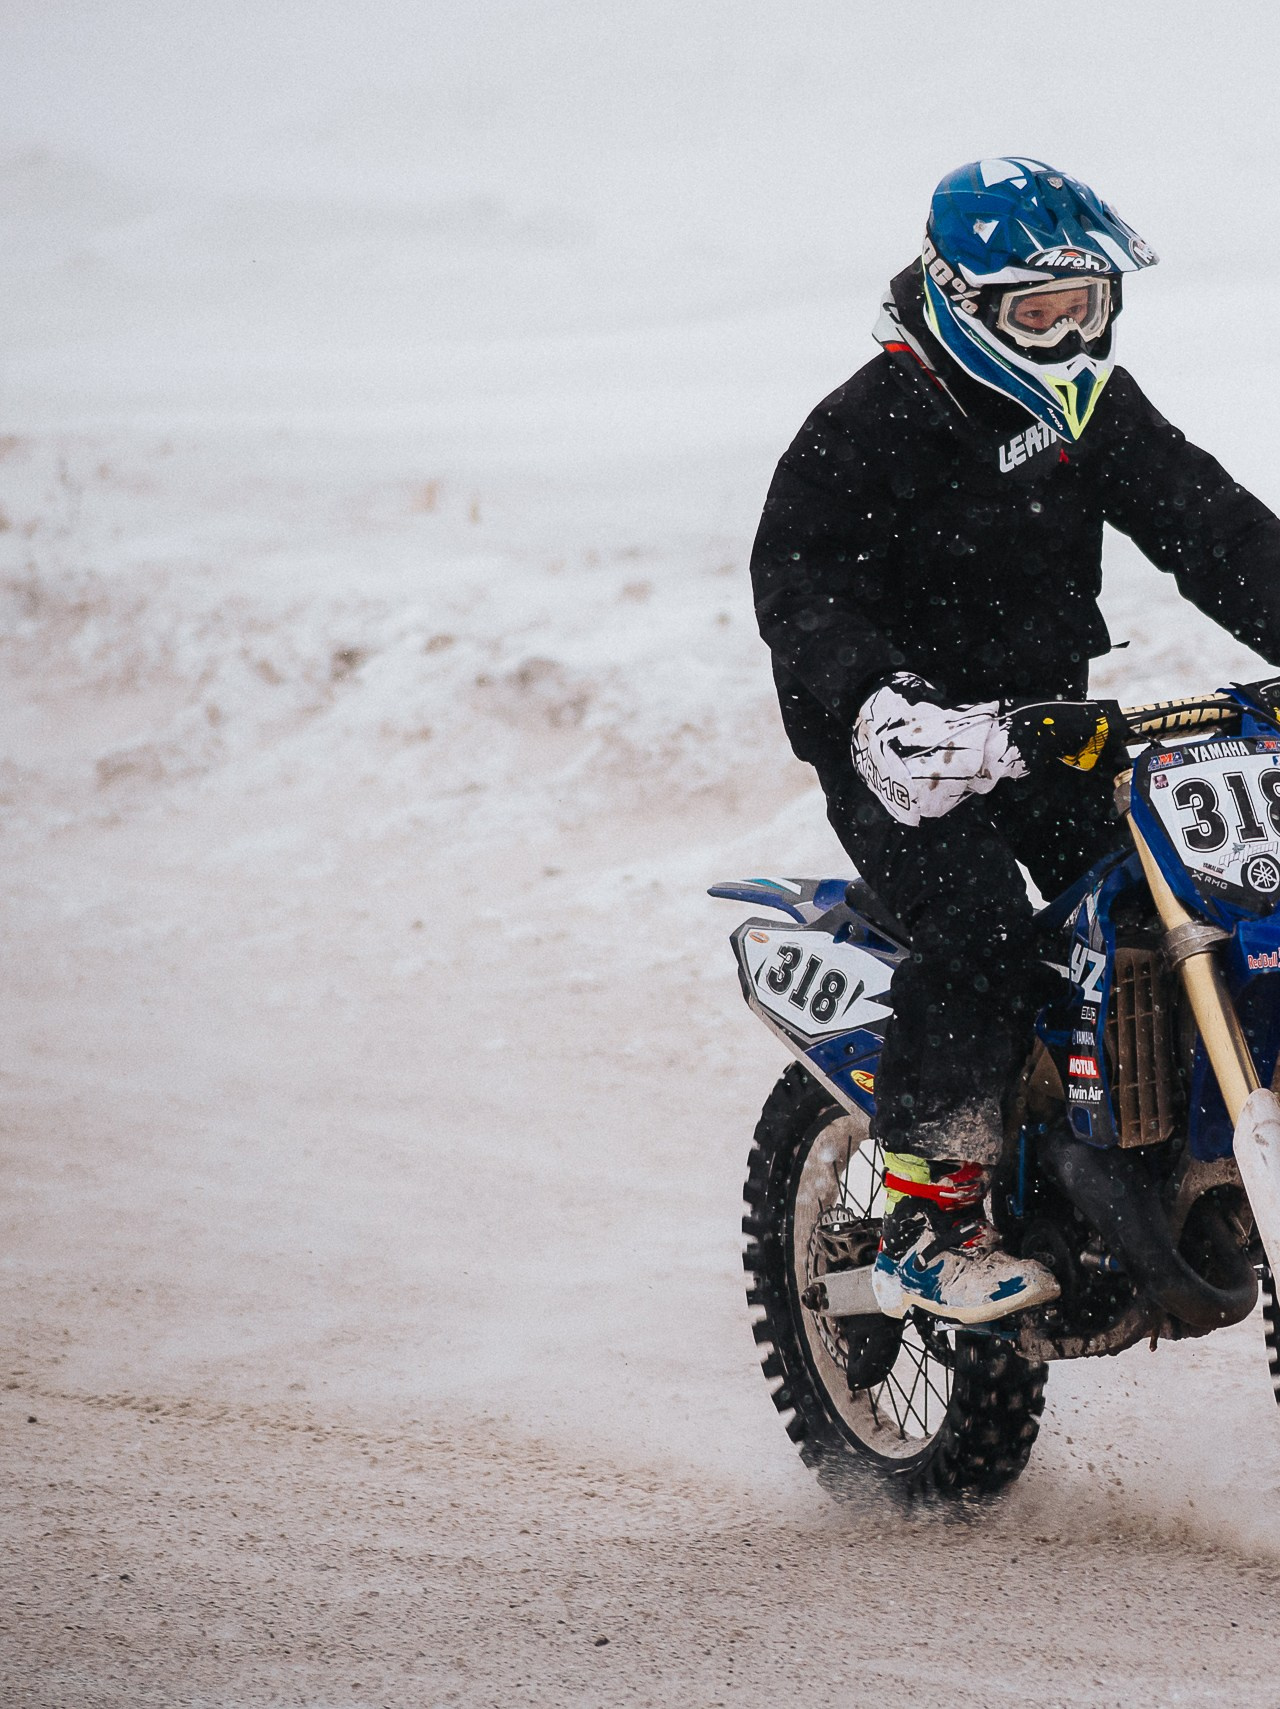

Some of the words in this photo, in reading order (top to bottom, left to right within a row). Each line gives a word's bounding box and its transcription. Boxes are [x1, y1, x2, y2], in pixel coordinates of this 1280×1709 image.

[1035, 250, 1100, 271] Airoh
[1188, 742, 1250, 762] YAMAHA
[1248, 954, 1264, 969] Red
[1263, 952, 1278, 968] Bull
[766, 942, 848, 1024] 318
[1071, 943, 1107, 1003] YZ
[1069, 1058, 1097, 1076] MOTUL
[1068, 1084, 1087, 1100] Twin
[1088, 1086, 1104, 1101] Air
